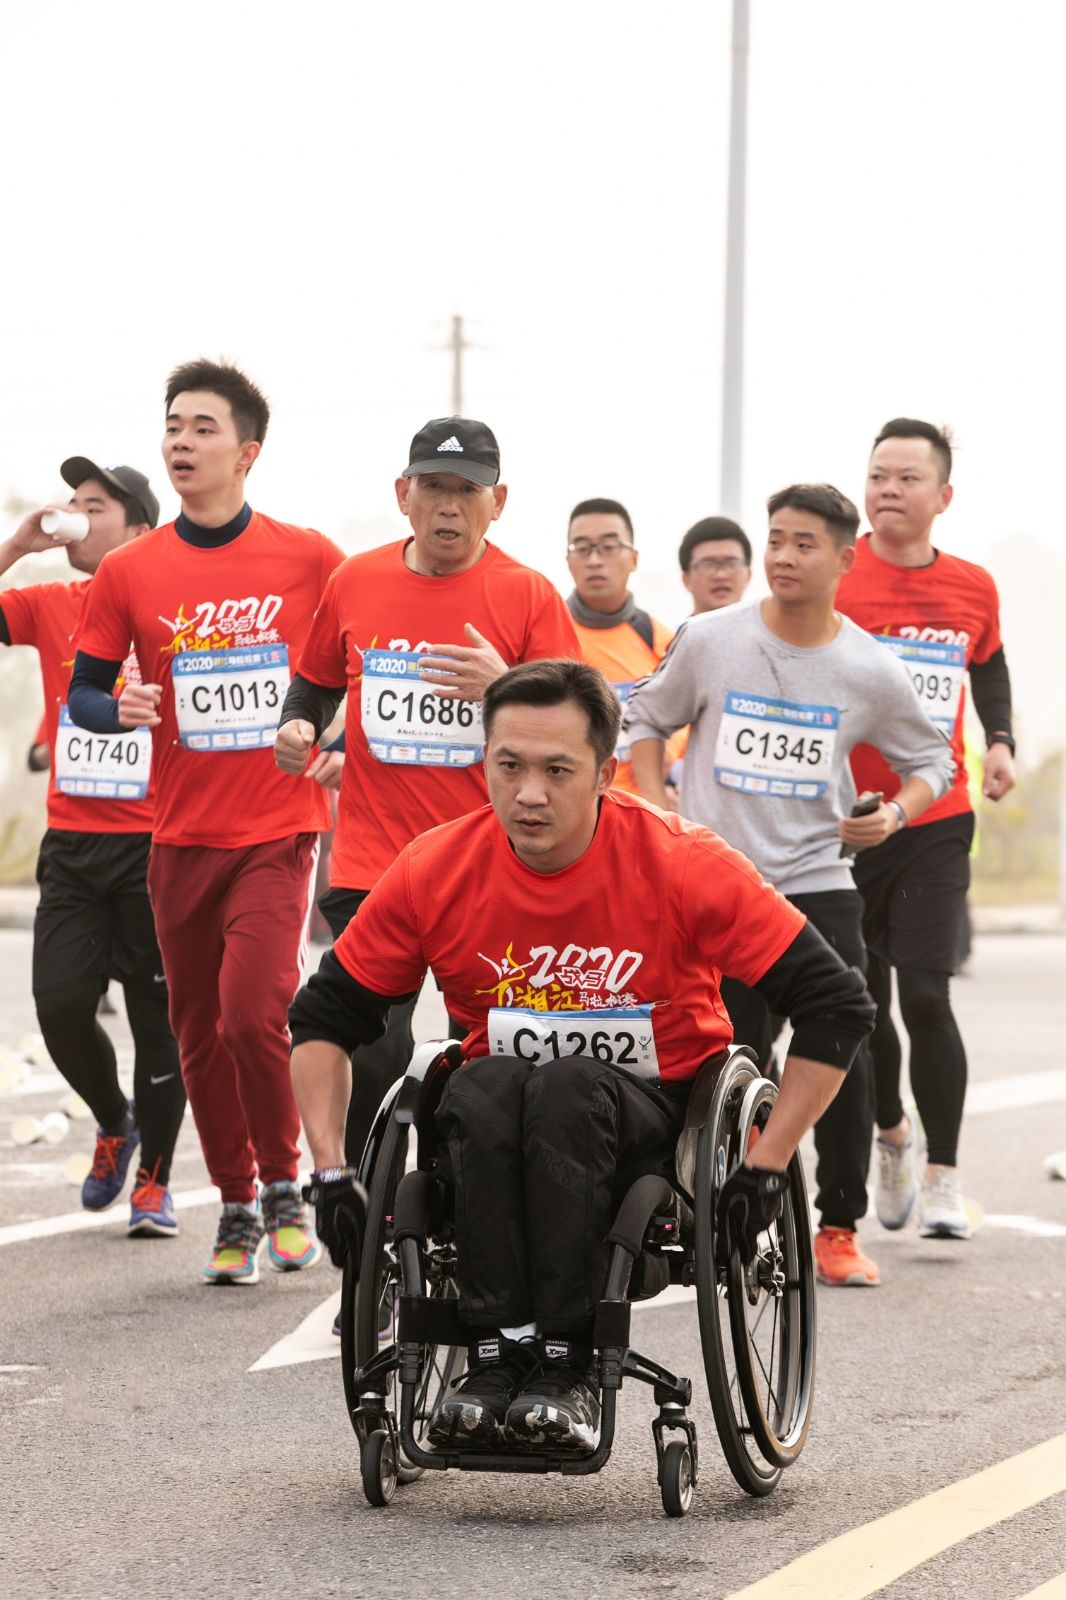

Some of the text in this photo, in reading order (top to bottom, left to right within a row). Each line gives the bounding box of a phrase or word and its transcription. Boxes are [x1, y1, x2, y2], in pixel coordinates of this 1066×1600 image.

[195, 594, 283, 638] 2020
[184, 656, 213, 671] 2020
[376, 657, 407, 674] 2020
[191, 680, 279, 714] C1013
[913, 673, 952, 701] 093
[377, 689, 473, 728] C1686
[737, 698, 767, 716] 2020
[67, 737, 139, 765] C1740
[735, 728, 823, 765] C1345
[528, 943, 644, 993] 2020
[512, 1027, 638, 1064] C1262
